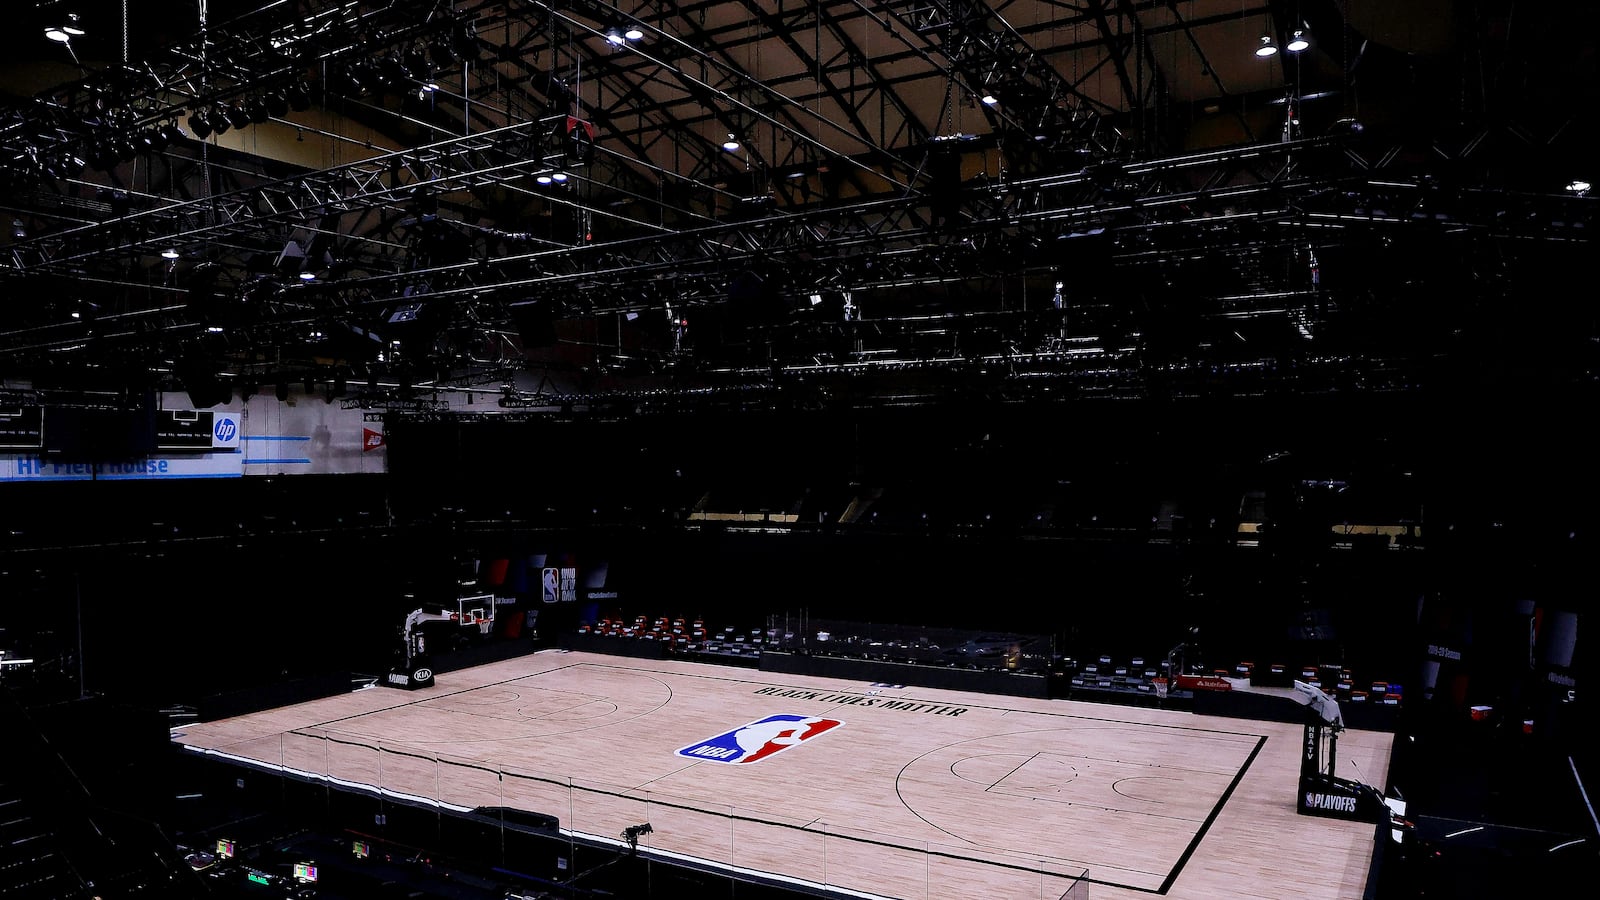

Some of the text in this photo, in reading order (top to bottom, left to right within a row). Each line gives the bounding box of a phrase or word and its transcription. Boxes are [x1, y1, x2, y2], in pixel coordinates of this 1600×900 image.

[216, 418, 235, 441] hp
[17, 456, 47, 475] HP
[416, 671, 429, 679] KIA
[753, 687, 968, 717] BLACK LIVES MATTER
[687, 745, 738, 759] NBA
[1314, 793, 1357, 812] PLAYOFFS
